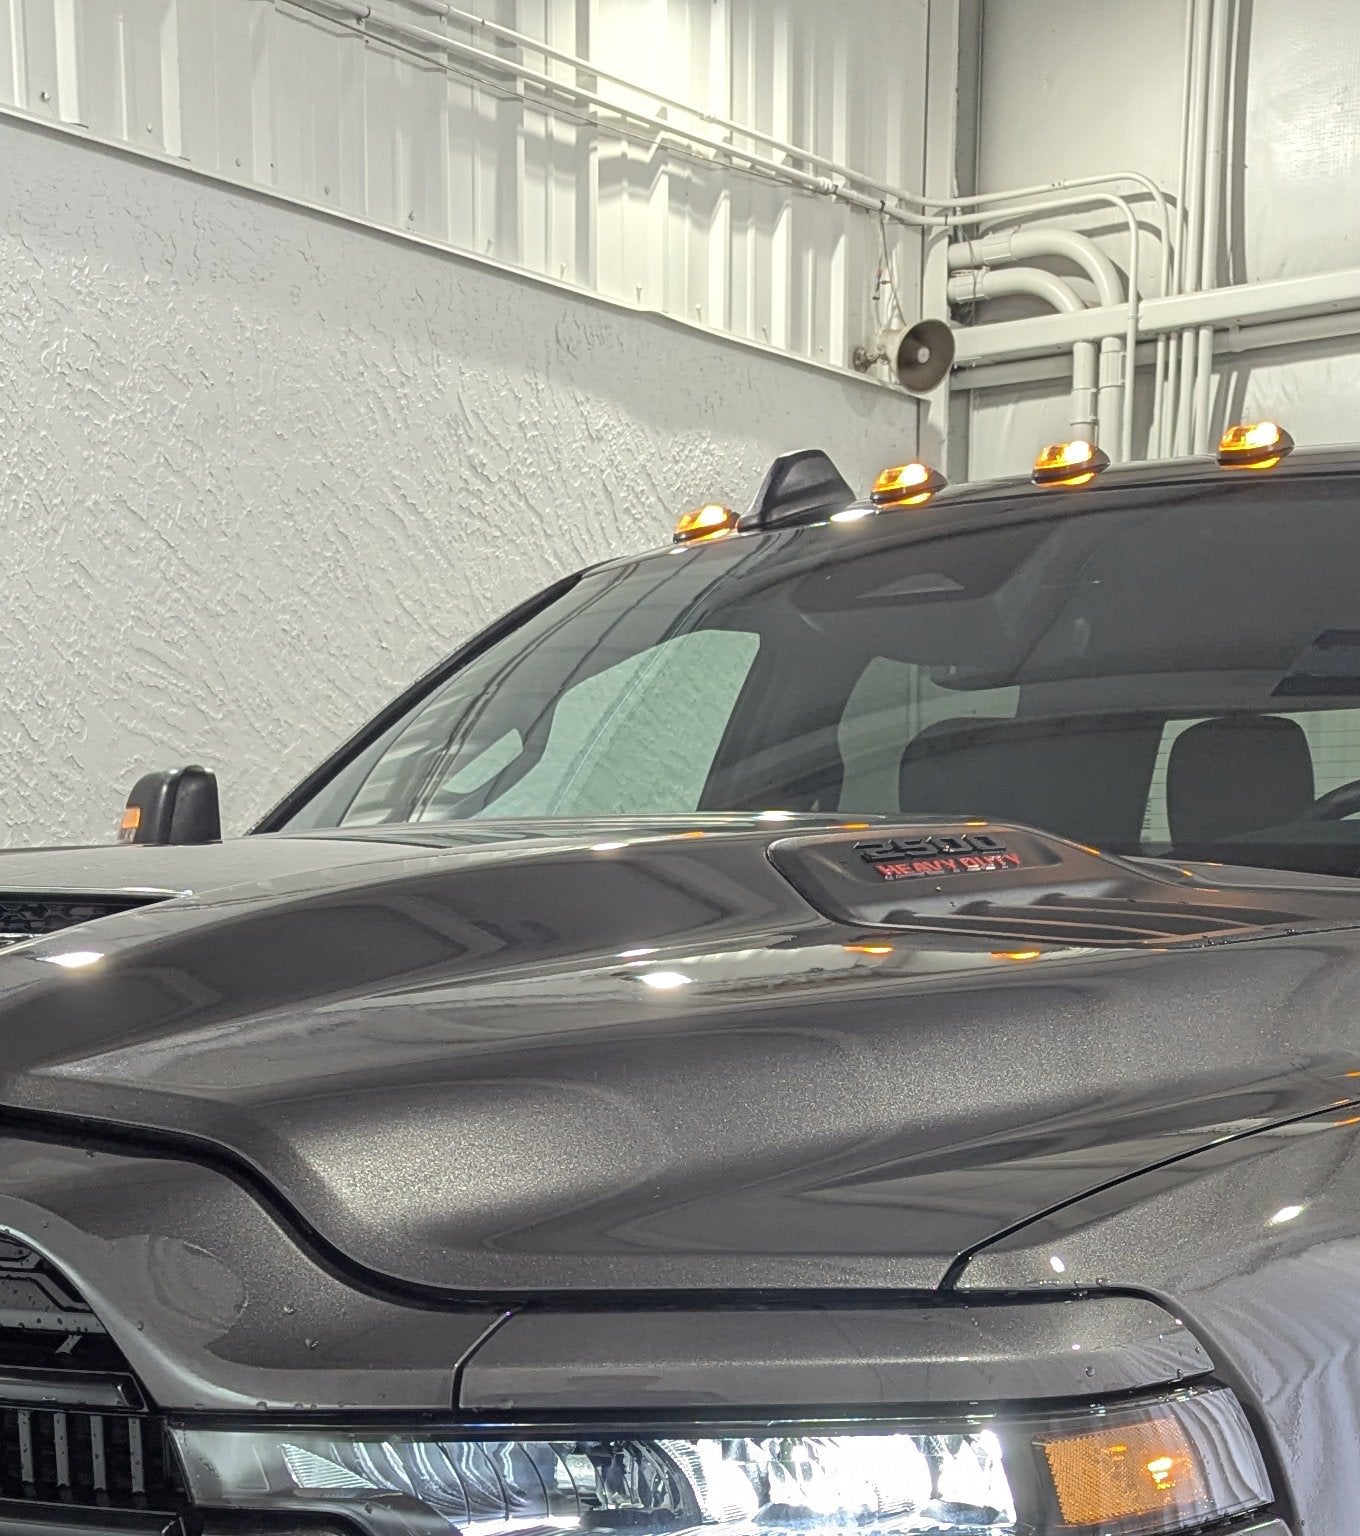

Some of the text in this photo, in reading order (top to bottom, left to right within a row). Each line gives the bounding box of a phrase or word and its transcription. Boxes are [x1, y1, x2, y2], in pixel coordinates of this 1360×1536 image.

[853, 833, 1007, 863] 2500
[873, 852, 1023, 881] HEAVY DUTY
